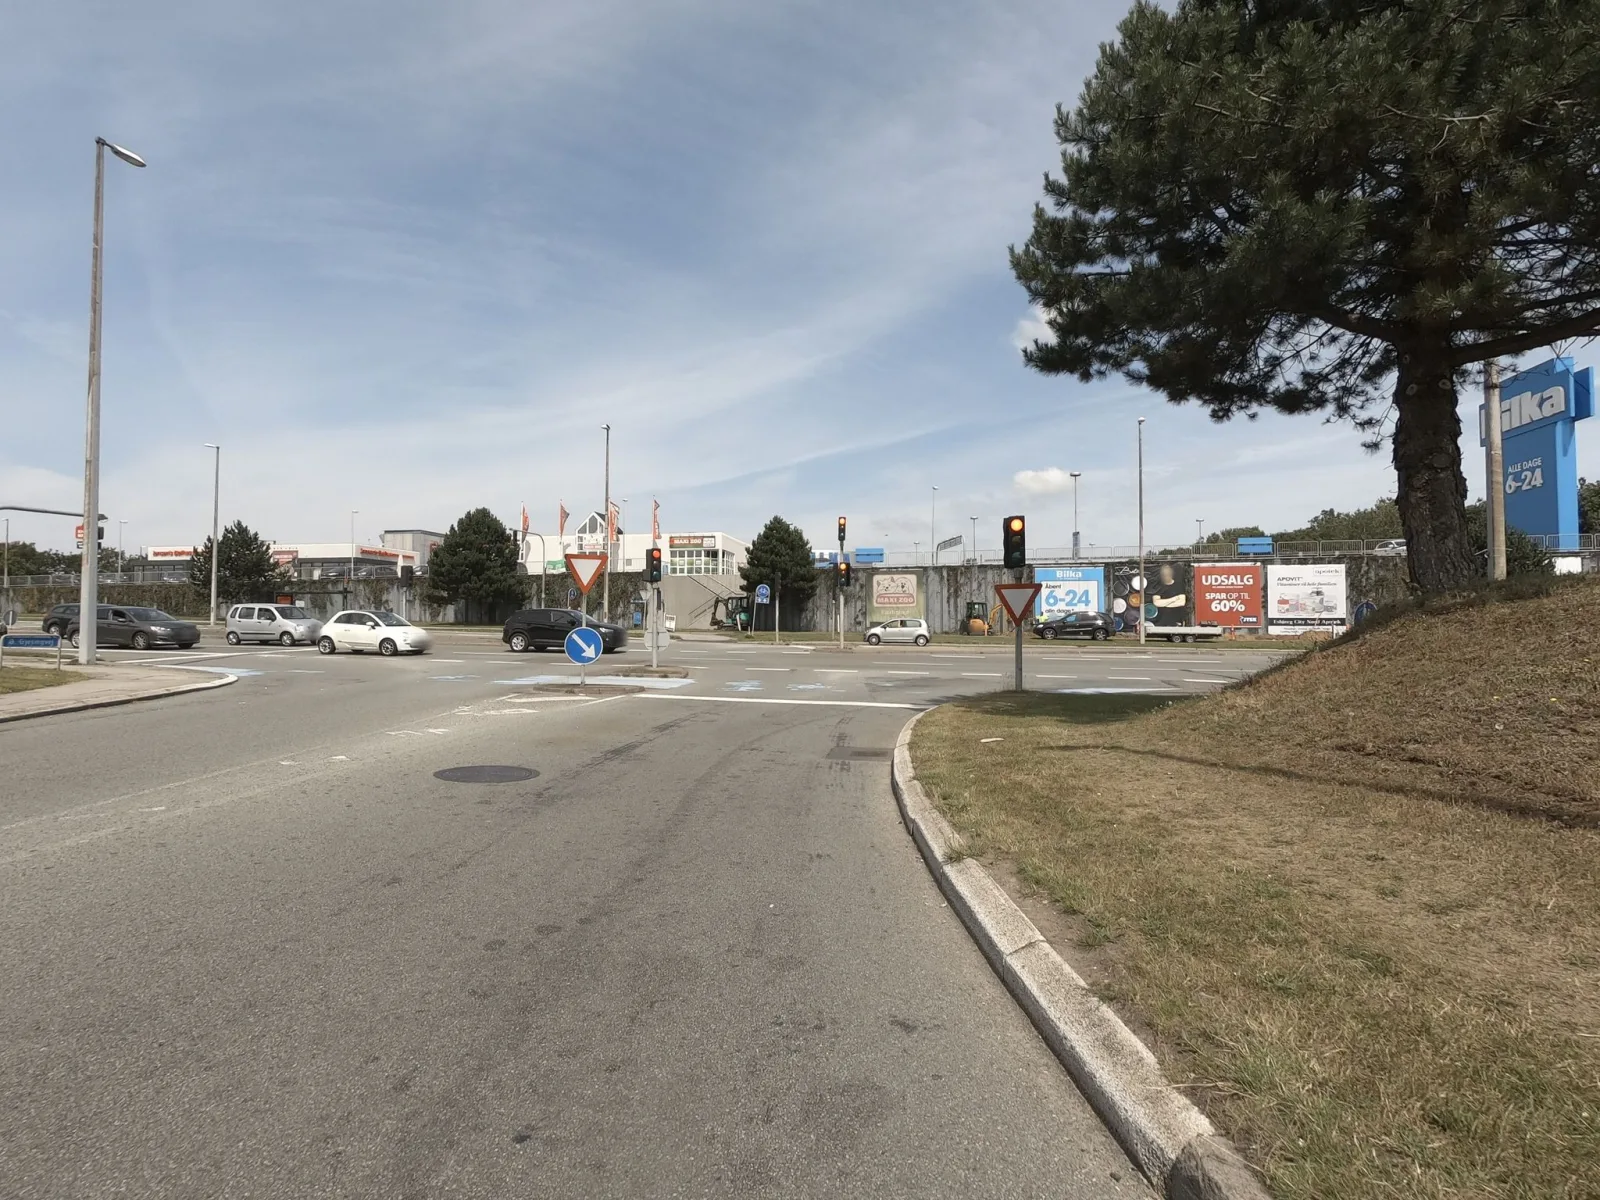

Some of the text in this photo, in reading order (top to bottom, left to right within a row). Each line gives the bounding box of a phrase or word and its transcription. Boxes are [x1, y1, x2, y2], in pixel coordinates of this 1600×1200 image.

[1481, 386, 1565, 439] ilka
[1507, 457, 1542, 474] ALLE DAGE
[1505, 468, 1544, 494] 6-24
[1056, 570, 1082, 578] Bilka
[1202, 574, 1254, 586] UDSALG
[1044, 589, 1091, 607] 6-24
[1205, 592, 1251, 600] SPAR OP TIL
[1211, 600, 1246, 612] 60%
